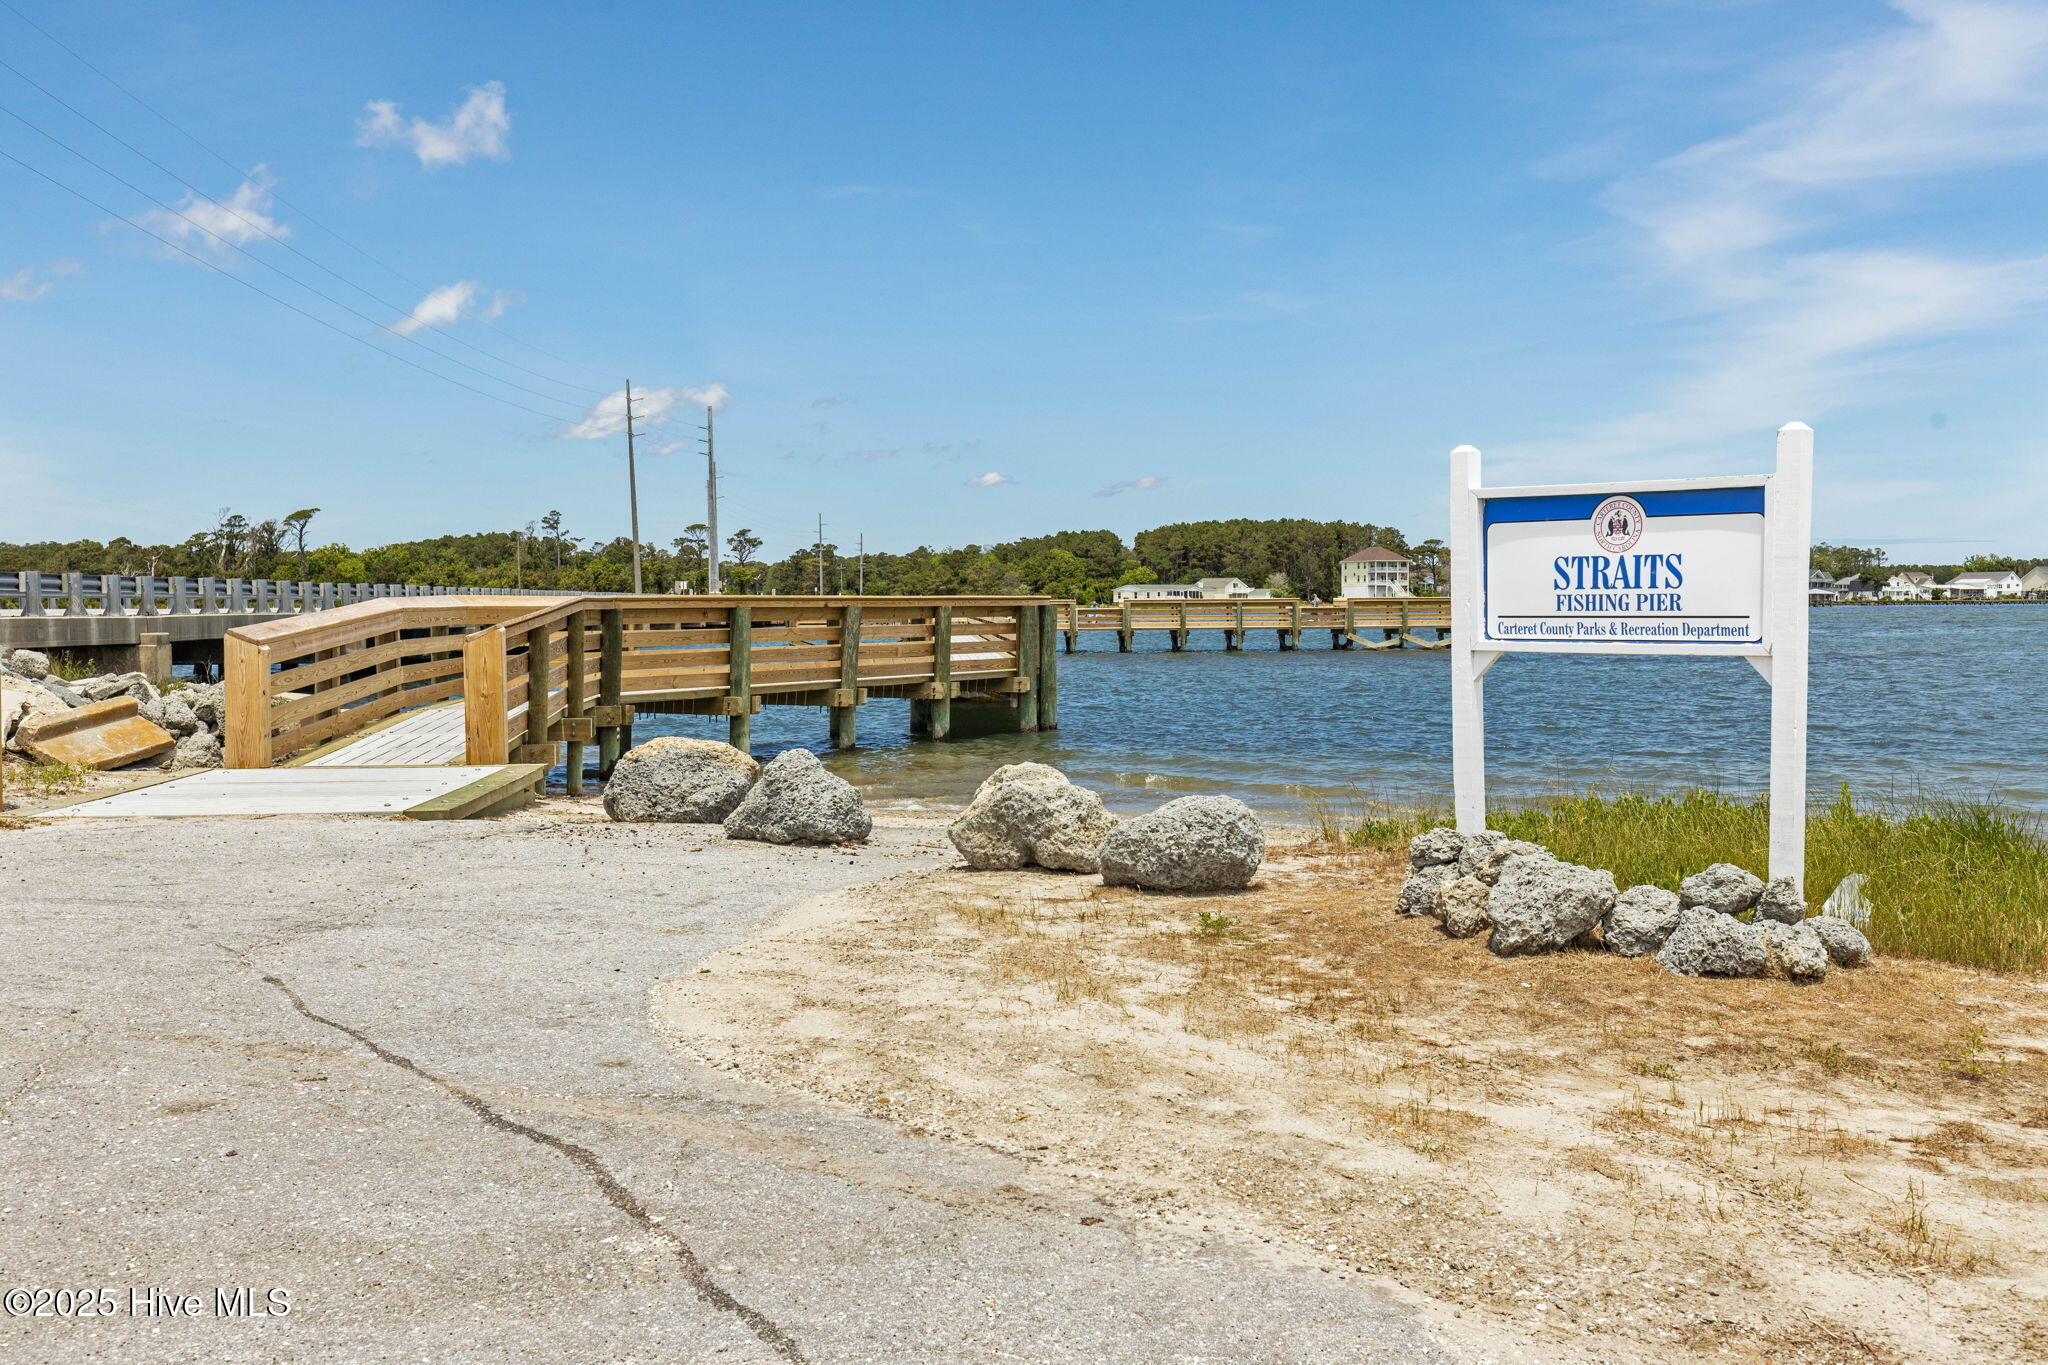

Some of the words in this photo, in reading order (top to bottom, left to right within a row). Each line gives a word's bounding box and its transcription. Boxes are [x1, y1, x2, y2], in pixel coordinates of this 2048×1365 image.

[1553, 553, 1683, 591] STRAITS
[1556, 593, 1630, 612] FISHING
[1636, 593, 1683, 612] PIER
[1497, 621, 1537, 636] Carteret
[1540, 621, 1574, 638] County
[1577, 621, 1607, 636] Parks
[1609, 622, 1618, 636] &
[1621, 622, 1679, 637] Recreation
[1682, 622, 1750, 639] Department
